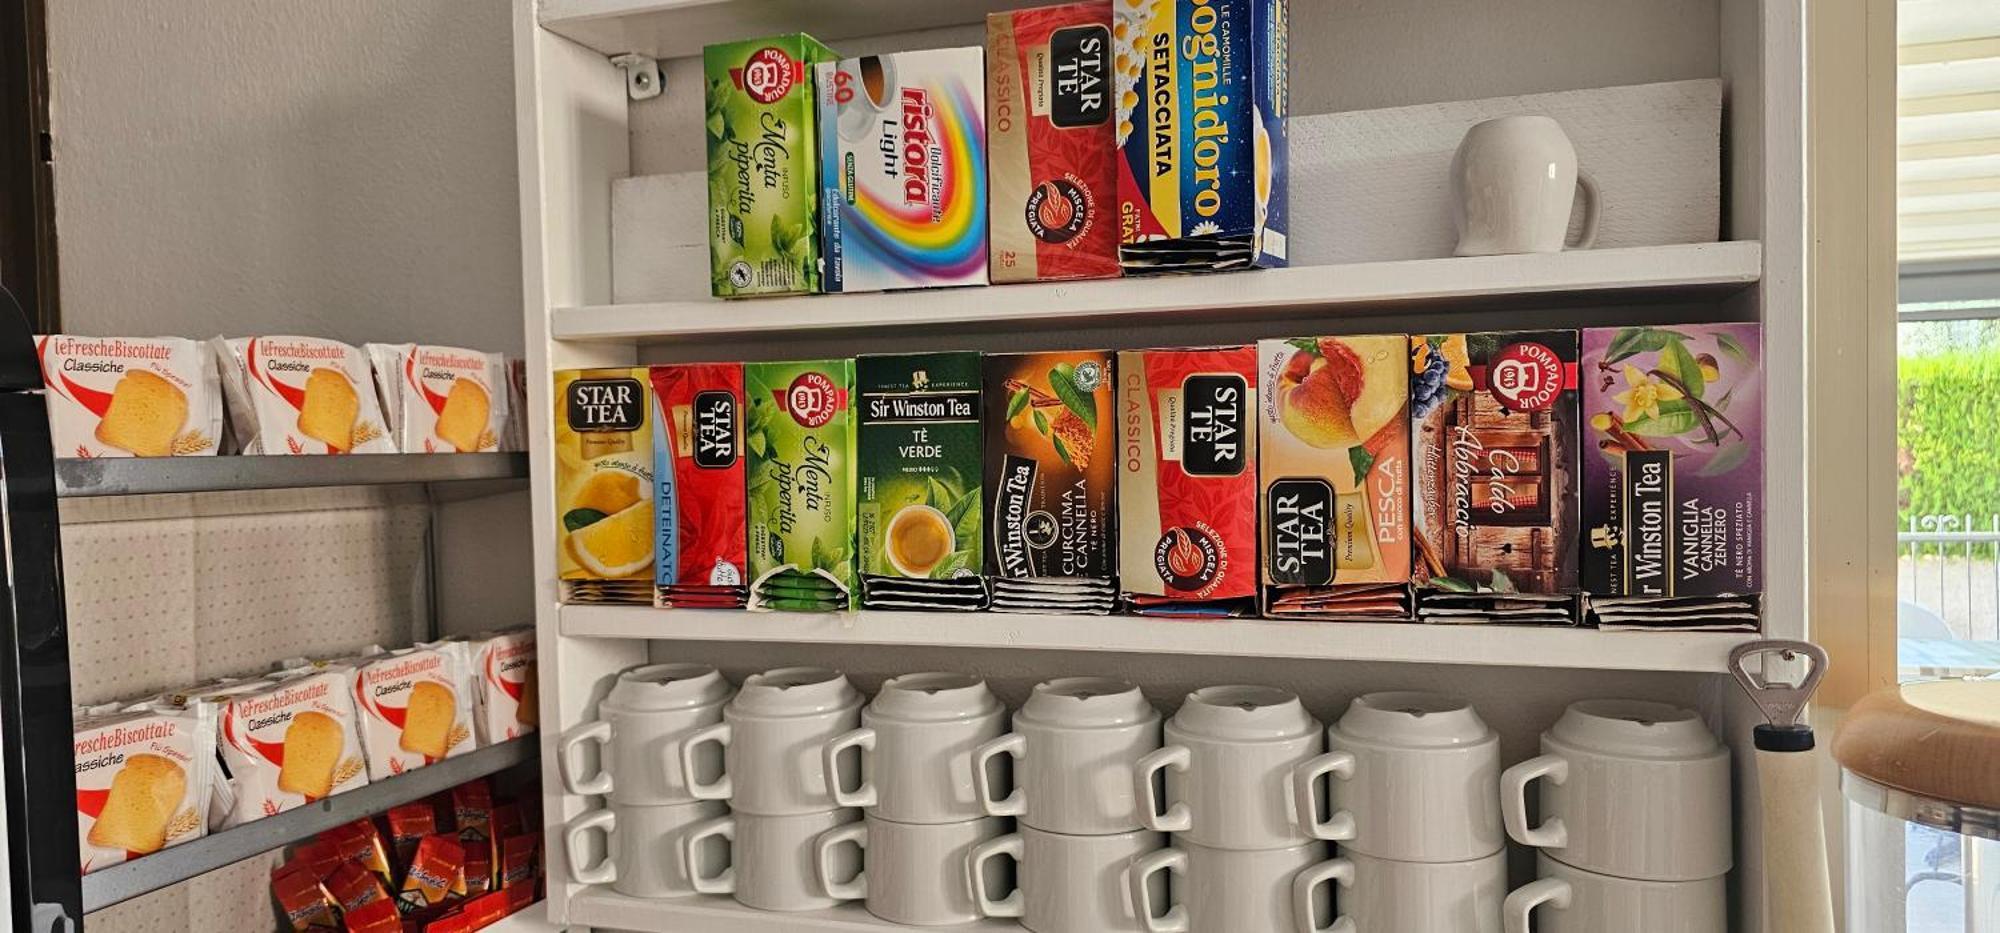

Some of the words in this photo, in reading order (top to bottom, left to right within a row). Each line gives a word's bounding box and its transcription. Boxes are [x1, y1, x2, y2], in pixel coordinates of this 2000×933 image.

[1220, 4, 1230, 18] LE
[1221, 20, 1231, 85] CAMOMILLE
[764, 49, 792, 103] POMPADOUR
[826, 71, 834, 106] BUSTINE
[834, 70, 854, 105] 60
[997, 34, 1011, 133] CLASSICO
[1058, 57, 1078, 96] TE
[1079, 38, 1101, 113] STAR
[1153, 32, 1171, 177] SETACCIATA
[1182, 0, 1228, 217] ognid'oro
[752, 112, 790, 189] Menta
[880, 119, 898, 179] Light
[901, 87, 934, 205] ristora
[728, 139, 755, 215] piperita
[930, 146, 944, 224] Dolcificante
[1064, 172, 1094, 209] SELEZIONE
[1028, 190, 1045, 238] PREGIATA
[1067, 187, 1084, 231] MISCELA
[1087, 210, 1094, 219] DI
[1066, 219, 1094, 250] QUALITÀ
[1003, 250, 1015, 267] 25
[55, 338, 171, 360] leFrescheBiscottate
[63, 358, 124, 373] Classiche
[260, 341, 345, 359] leFrescheBiscottate
[268, 359, 310, 373] Classiche
[422, 367, 456, 380] Classiche
[577, 385, 632, 405] STAR
[1502, 367, 1513, 388] 1913
[1519, 344, 1559, 409] POMPADOUR
[583, 404, 627, 423] TEA
[807, 374, 834, 426] POMPADOUR
[870, 396, 890, 419] Sir
[892, 399, 945, 417] Winston
[946, 398, 971, 416] Tea
[700, 407, 715, 452] TEA
[715, 400, 731, 458] STAR
[912, 428, 928, 443] TÈ
[1126, 373, 1140, 473] CLASSICO
[1190, 405, 1213, 443] TE
[1215, 387, 1237, 463] STAR
[795, 435, 832, 511] Menta
[899, 445, 942, 458] VERDE
[1393, 459, 1402, 485] frutta
[770, 457, 797, 534] piperita
[1009, 465, 1029, 491] Tea
[1378, 456, 1395, 543] PESCA
[1394, 486, 1402, 496] di
[1452, 425, 1485, 538] Abbraccio
[1488, 449, 1520, 514] Caldo
[1610, 465, 1618, 520] EXPERIENCE
[1635, 462, 1662, 497] Tea
[1004, 493, 1024, 568] Winston
[1061, 490, 1073, 575] CURCUMA
[1076, 479, 1087, 568] CANNELLA
[1277, 492, 1300, 574] STAR
[1301, 501, 1324, 564] TEA
[1343, 502, 1353, 530] Quality
[1714, 508, 1727, 565] ZENZERO
[1735, 501, 1743, 541] SPEZIATO
[1157, 537, 1174, 584] PREGIATA
[1195, 520, 1228, 558] SELEZIONE
[1199, 537, 1216, 582] MISCELA
[1343, 530, 1353, 562] Premium
[1635, 501, 1662, 581] Winston
[1683, 498, 1699, 580] VANIGLIA
[1701, 507, 1713, 571] CANNELLA
[1735, 543, 1743, 566] NERO
[1197, 570, 1227, 599] QUALITÀ
[1220, 559, 1228, 569] DI
[1735, 568, 1743, 578] TÈ
[238, 682, 328, 719] leFrescheBiscottate
[375, 679, 412, 697] Classiche
[248, 710, 293, 731] Classiche
